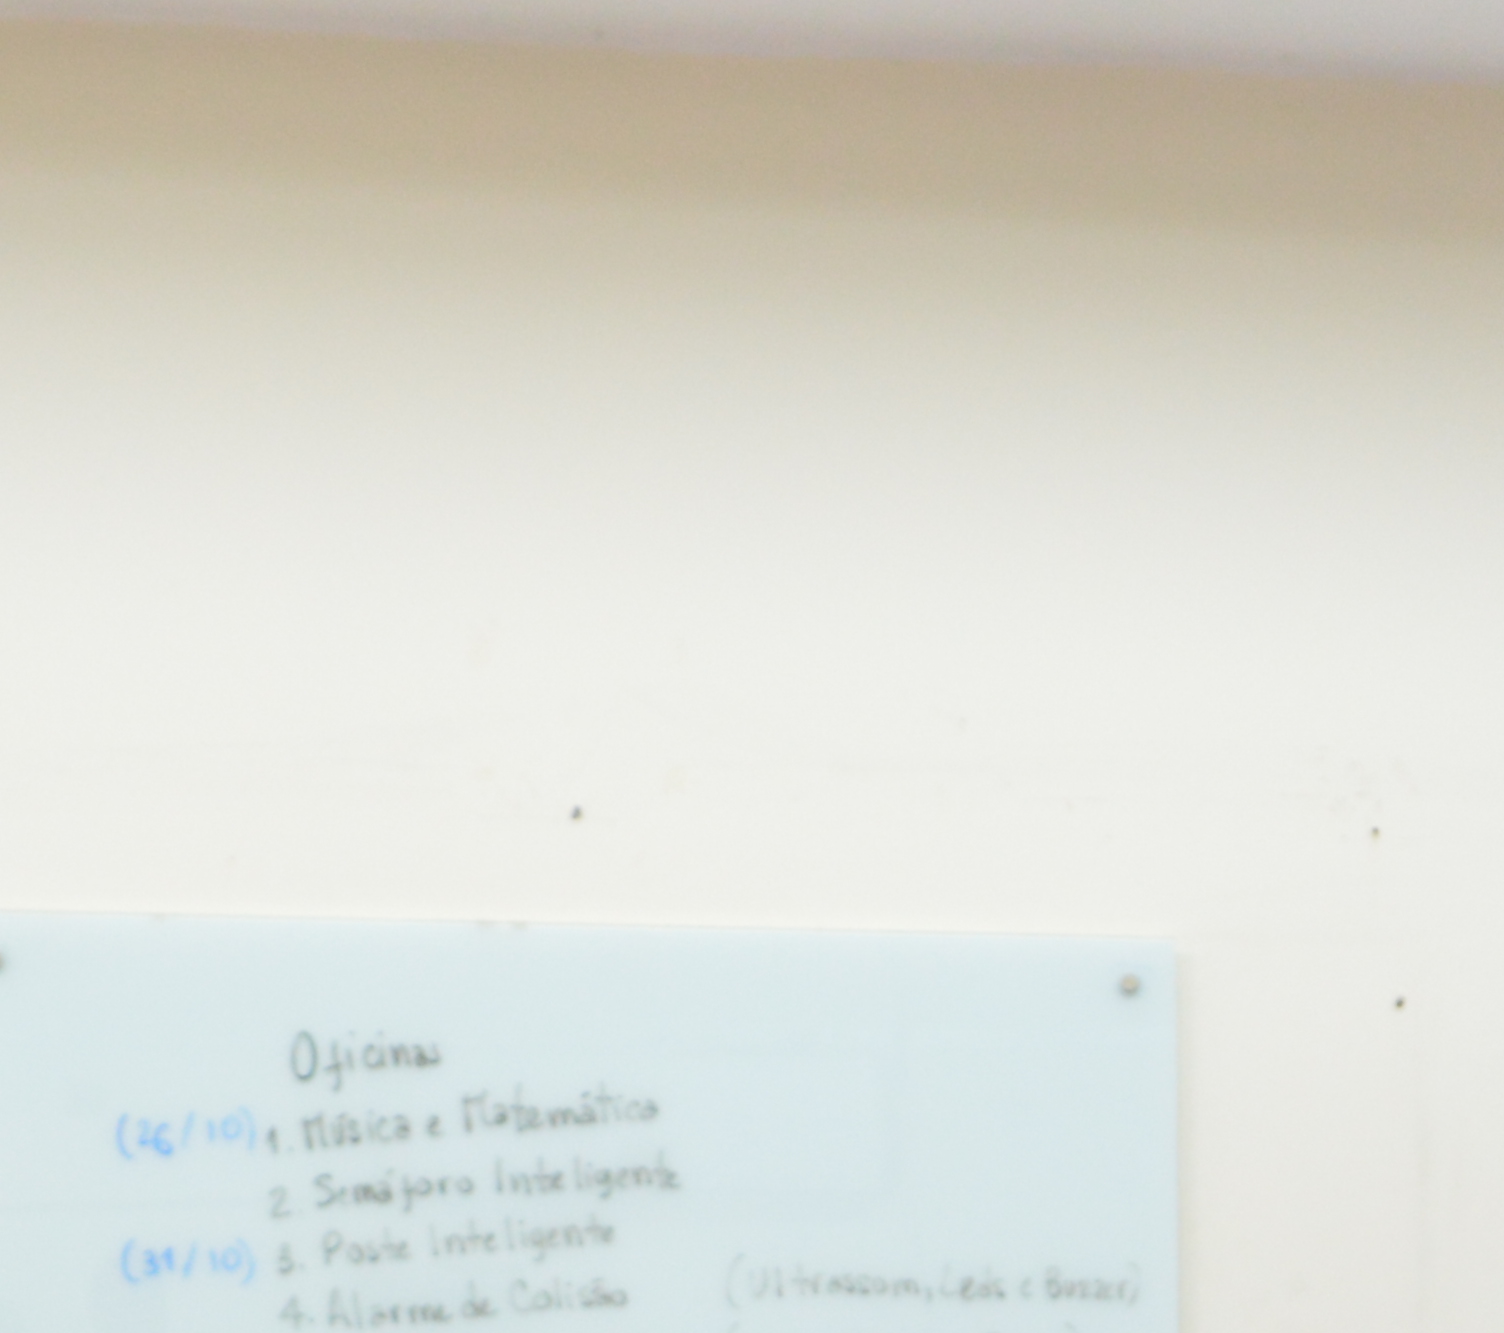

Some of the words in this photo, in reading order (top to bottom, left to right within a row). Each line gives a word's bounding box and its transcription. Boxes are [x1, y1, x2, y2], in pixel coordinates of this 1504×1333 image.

[288, 1029, 443, 1094] Oficinas
[493, 1149, 682, 1196] Inteligente
[427, 1212, 617, 1262] Inteligente
